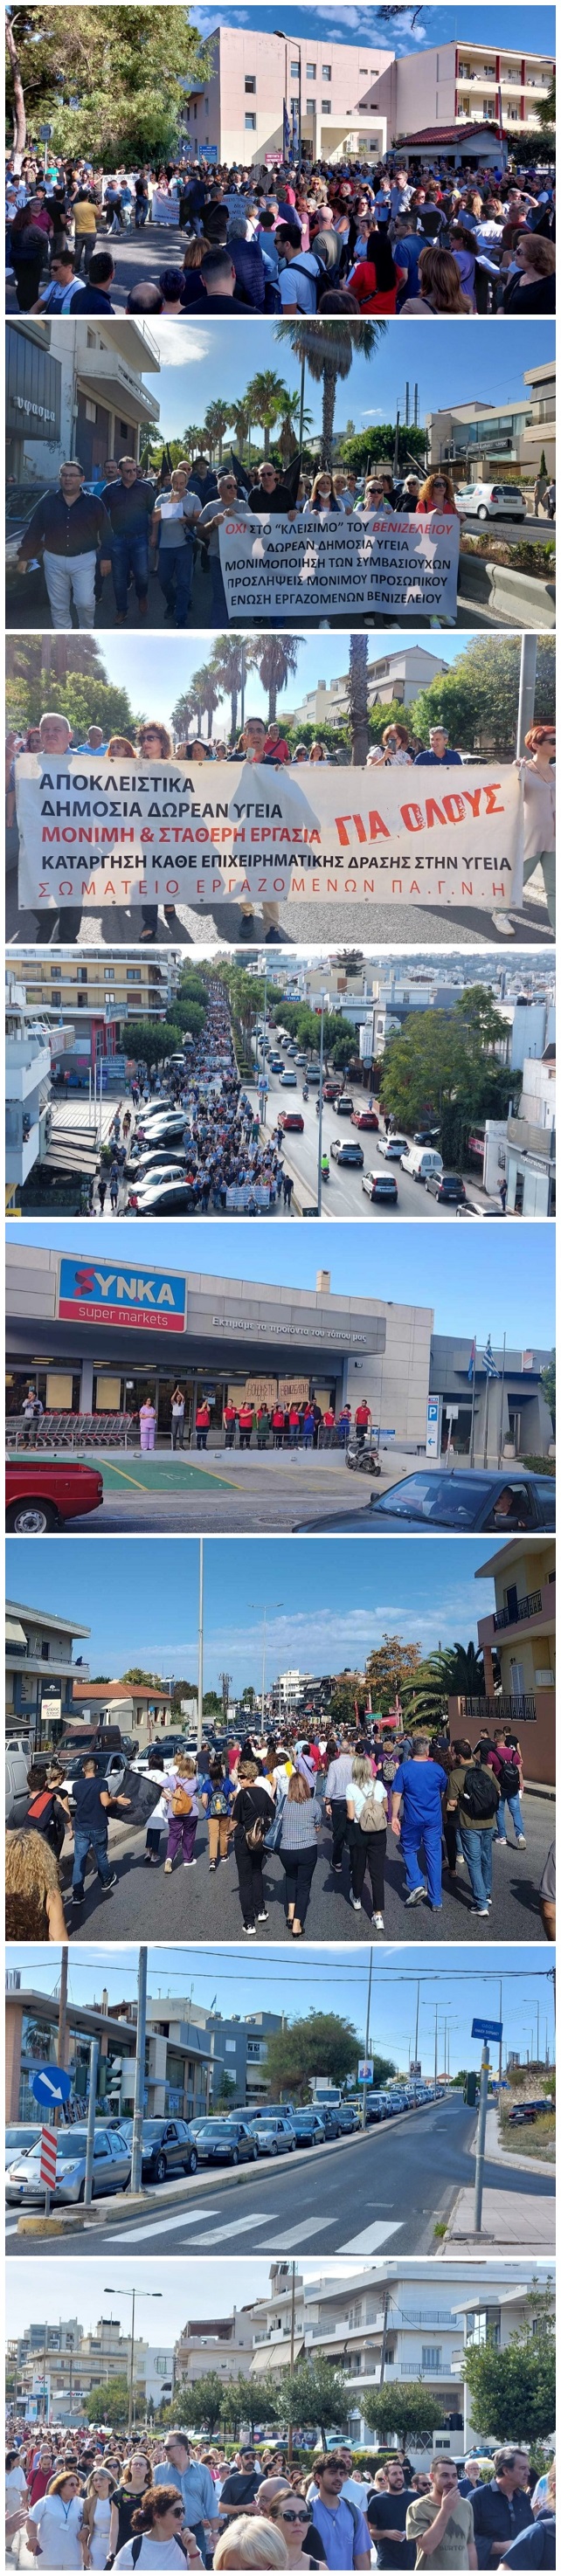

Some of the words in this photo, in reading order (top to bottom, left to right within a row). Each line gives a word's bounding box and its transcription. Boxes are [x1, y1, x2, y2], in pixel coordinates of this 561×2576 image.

[225, 523, 246, 535] ΟΧΙ
[249, 524, 272, 535] ΣΤΟ
[347, 522, 369, 532] ΤΟΥ
[372, 522, 454, 535] ΒΕΝΙΖΕΛΕΙΟΥ
[267, 541, 315, 552] ΔΩΡΕΑΝ
[318, 540, 373, 551] ΔΗΜΟΣΙΑ
[377, 540, 409, 551] ΥΓΕΙΑ
[225, 558, 325, 571] ΜΟΝΙΜΟΠΟΙΗΣΗ
[329, 557, 353, 568] ΤΩΝ
[357, 556, 451, 570] ΣΥΜΒΑΣΙΟΥΧΩΝ
[227, 576, 303, 589] ΠΡΟΣΛΗΨΕΙΣ
[307, 575, 368, 586] ΜΟΝΙΜΟΥ
[371, 574, 448, 587] ΠΡΟΣΩΠΙΚΟΥ
[231, 594, 271, 605] ΕΝΩΣΗ
[275, 592, 364, 604] ΕΡΓΑΖΟΜΕΝΩΝ
[367, 591, 442, 604] ΒΕΝΙΖΕΛΕΙΟΥ
[39, 773, 195, 793] ΑΠΟΚΛΕΙΣΤΙΚΑ
[40, 800, 142, 818] ΔΗΜΟΣΙΑ
[147, 802, 228, 818] ΔΩΡΕΑΝ
[233, 804, 283, 818] ΥΓΕΙΑ
[335, 810, 391, 846] ΓΙΑ
[399, 784, 505, 832] ΟΛΟΥΣ
[41, 826, 135, 843] ΜΟΝΙΜΗ
[140, 827, 155, 843] &
[158, 827, 246, 843] ΣΤΑΘΕΡΗ
[251, 827, 322, 844] ΕΡΓΑΣΙΑ
[42, 855, 147, 870] ΚΑΤΑΡΓΗΣΗ
[151, 855, 197, 868] ΚΑΘΕ
[201, 854, 344, 868] ΕΠΙΧΕΙΡΗΜΑΤΙΚΗΣ
[348, 856, 411, 869] ΔΡΑΣΗΣ
[414, 856, 458, 869] ΣΤΗΝ
[462, 857, 512, 871] ΥΓΕΙΑ
[38, 880, 179, 898] ΣΩΜΑΤΕΙΟ
[197, 878, 374, 894] ΕΡΓΑΖΟΜΕΝΩΝ
[79, 1307, 115, 1319] super
[119, 1311, 168, 1326] markets
[211, 1316, 254, 1329] Εκτιμάμε
[327, 1329, 350, 1339] τόπου
[352, 1334, 367, 1343] μας
[429, 1407, 437, 1419] P
